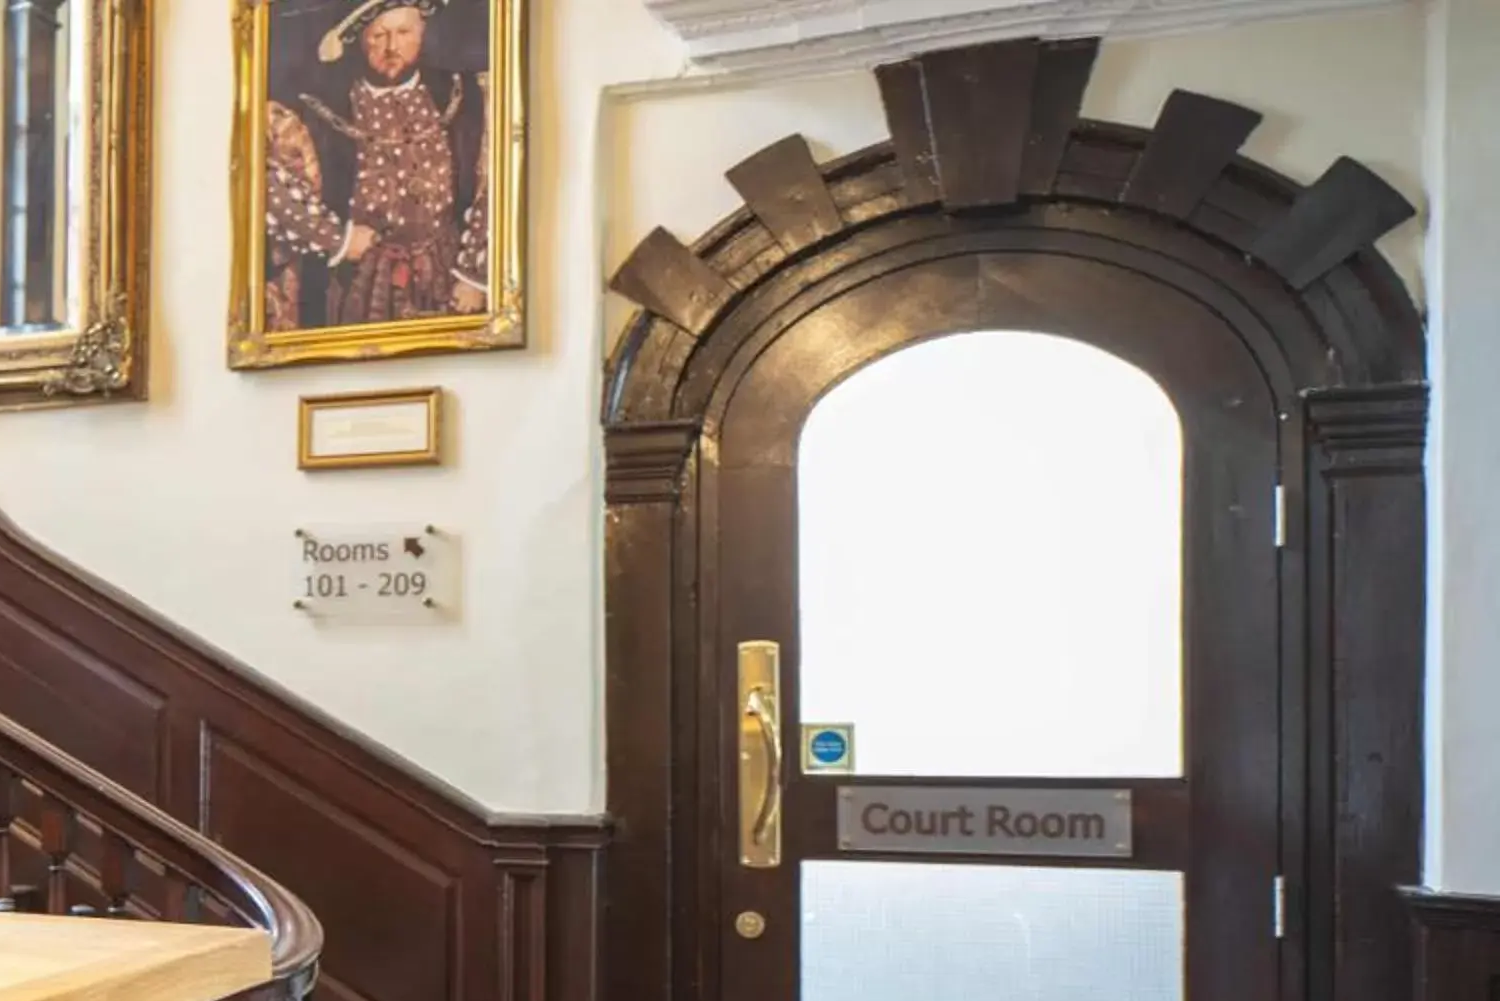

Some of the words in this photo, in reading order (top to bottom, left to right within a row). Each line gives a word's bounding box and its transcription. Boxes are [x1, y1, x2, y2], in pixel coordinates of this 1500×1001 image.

[303, 539, 389, 562] Rooms
[305, 574, 348, 597] 101
[377, 572, 426, 596] 209
[861, 802, 974, 836] Court
[986, 805, 1105, 839] Room
